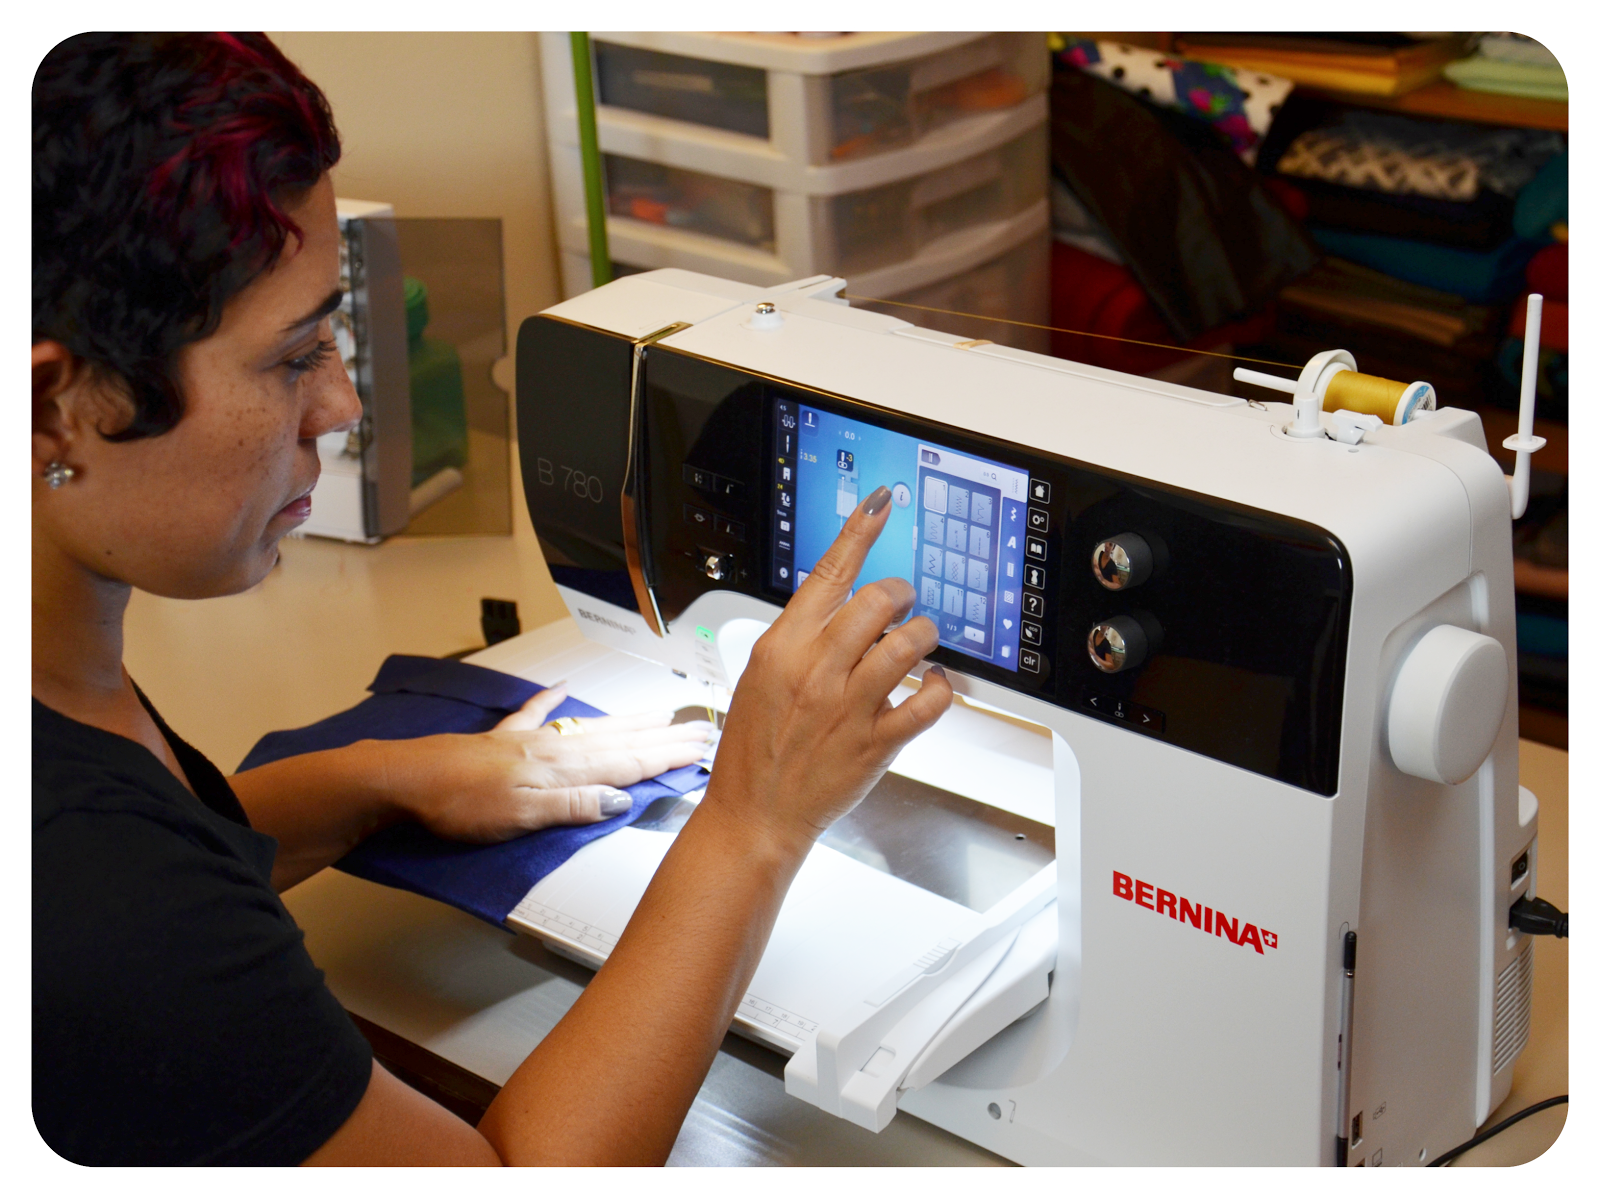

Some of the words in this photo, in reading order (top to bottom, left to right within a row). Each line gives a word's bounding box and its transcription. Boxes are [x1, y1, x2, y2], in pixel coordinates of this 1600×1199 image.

[844, 430, 856, 441] 0.0
[537, 457, 554, 486] B
[561, 465, 604, 503] 780
[1028, 625, 1039, 633] eco
[1023, 655, 1037, 666] clr
[1112, 869, 1265, 956] BERNINA
